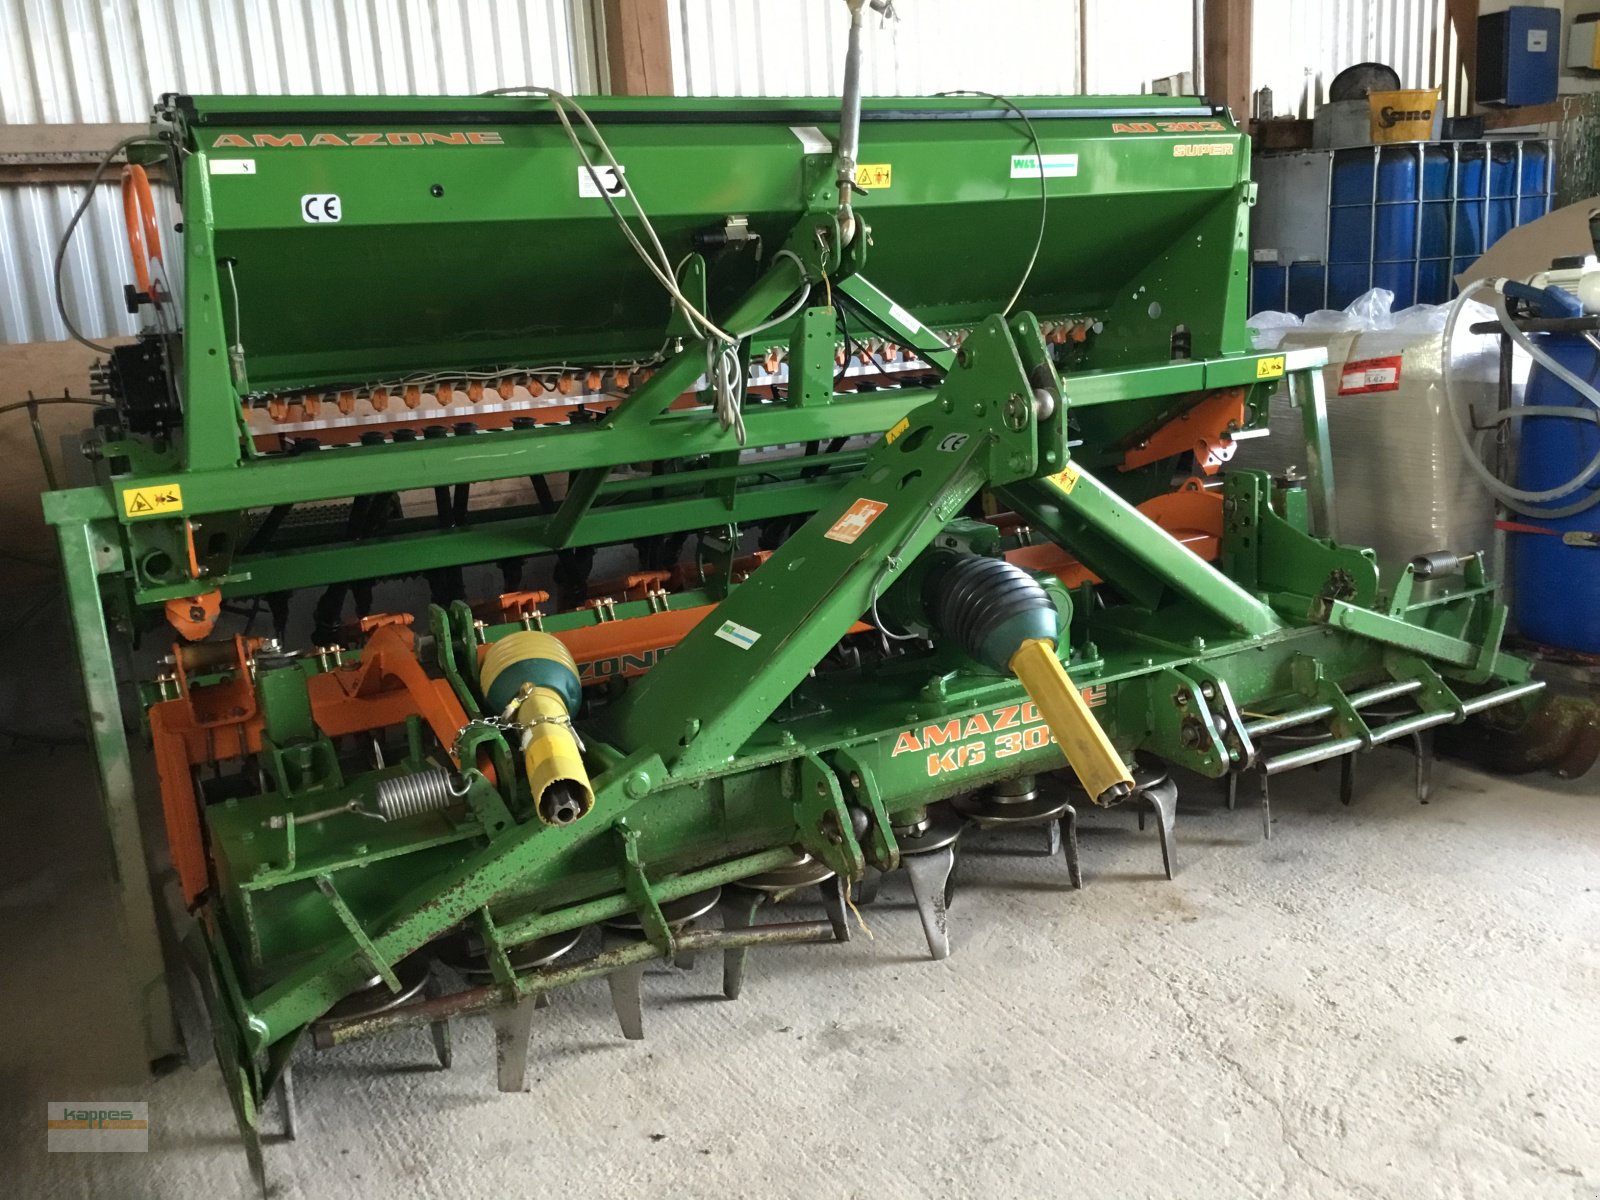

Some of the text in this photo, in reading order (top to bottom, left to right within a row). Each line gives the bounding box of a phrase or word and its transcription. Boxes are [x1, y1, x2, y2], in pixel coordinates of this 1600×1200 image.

[1112, 121, 1226, 133] AD 303
[1378, 106, 1431, 129] Sano
[212, 132, 504, 147] AMAZONE
[1173, 143, 1233, 157] SUPER
[305, 197, 338, 220] CE
[941, 434, 967, 451] CE
[891, 684, 1107, 757] AMAZOE
[927, 724, 1058, 777] KG 30
